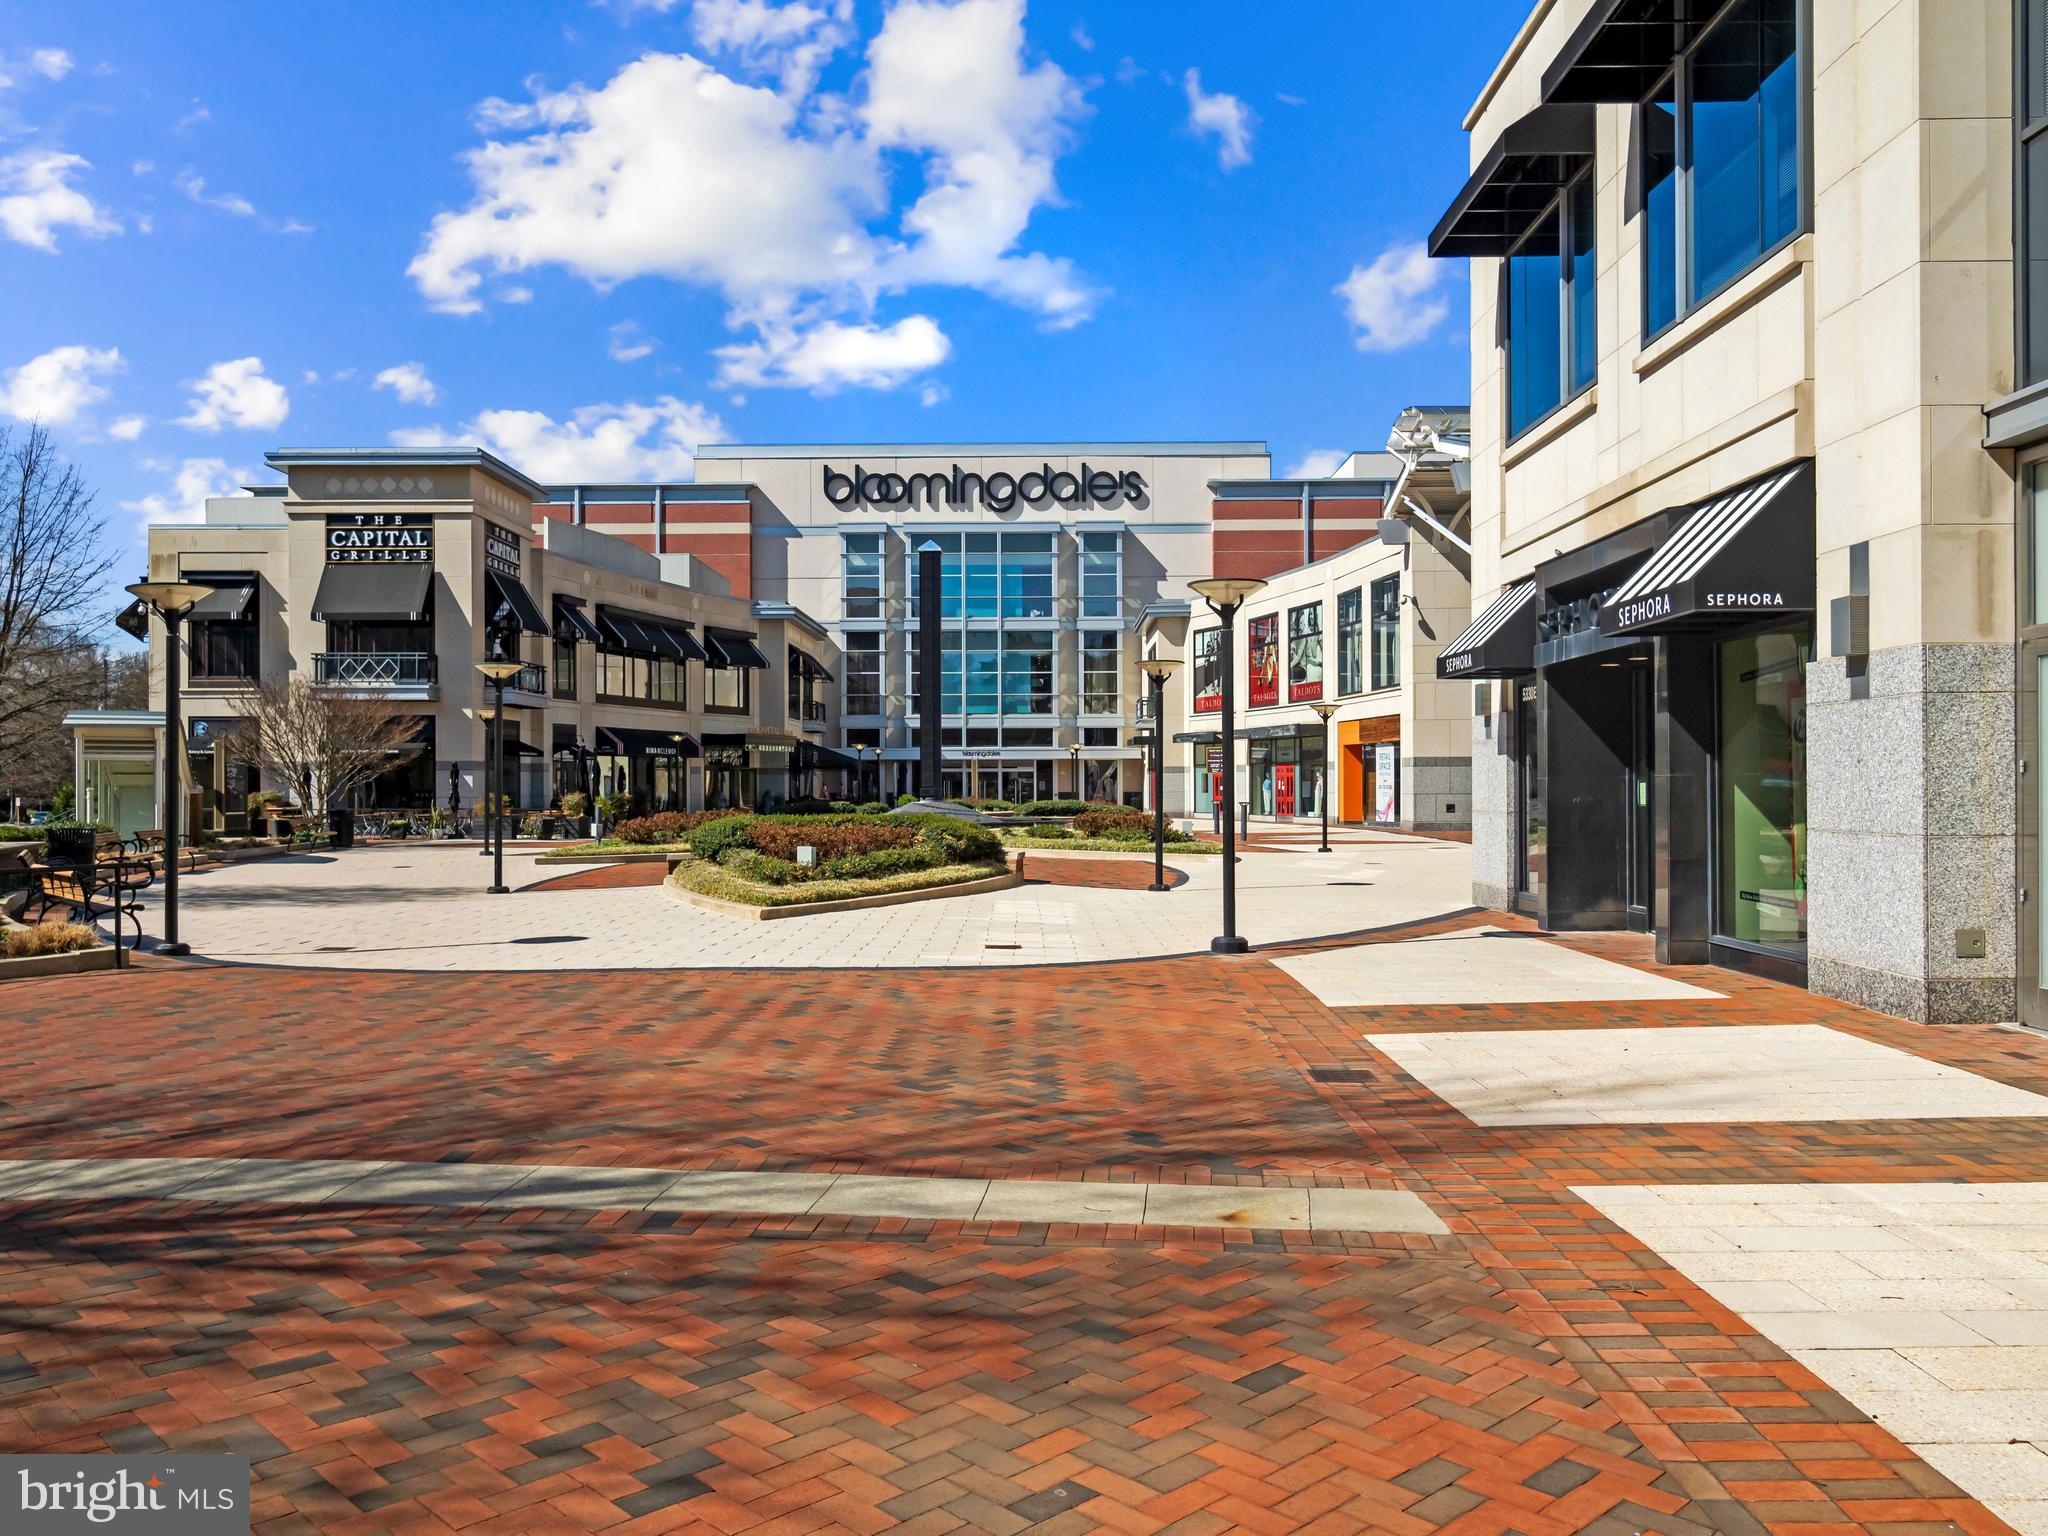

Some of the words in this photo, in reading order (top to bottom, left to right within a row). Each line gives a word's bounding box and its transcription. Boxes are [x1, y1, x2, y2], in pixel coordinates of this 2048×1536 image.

[823, 462, 1143, 513] bloomingdale's
[355, 515, 402, 525] THE
[331, 530, 428, 546] CAPITAL
[488, 538, 520, 565] CAPITAL
[1706, 593, 1783, 606] SEPHORA
[1618, 593, 1671, 627] SEPHORA
[1445, 653, 1473, 673] SEPHORA
[1253, 692, 1278, 702] TALBOTS
[1294, 685, 1321, 697] TALBOTS
